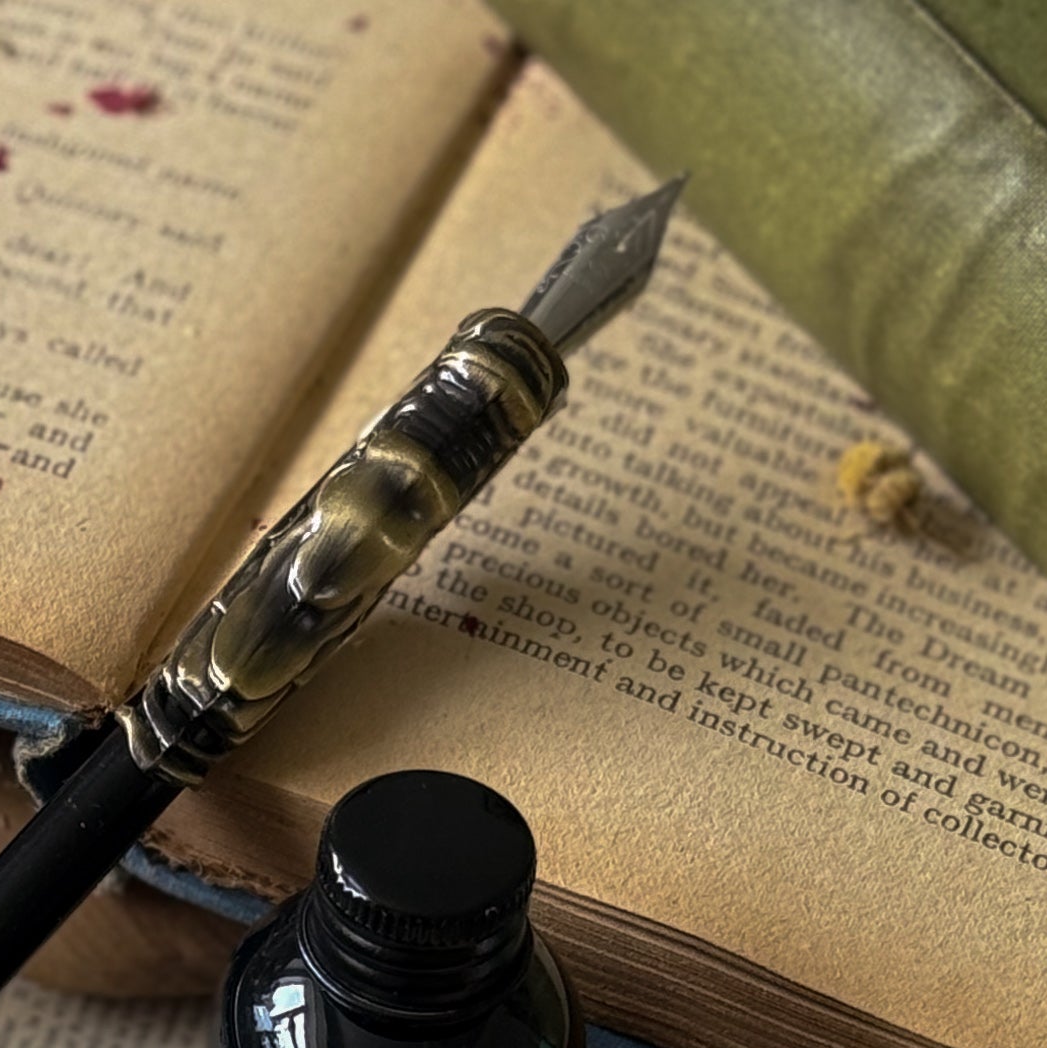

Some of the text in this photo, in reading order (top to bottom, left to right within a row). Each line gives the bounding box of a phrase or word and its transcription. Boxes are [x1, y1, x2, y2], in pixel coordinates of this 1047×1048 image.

[46, 337, 145, 377] called
[54, 399, 110, 427] she
[9, 449, 77, 480] and
[27, 422, 95, 454] and
[623, 452, 735, 516] talking
[743, 498, 840, 556] about
[846, 539, 896, 578] his
[513, 470, 1031, 699] details bored her. The Dream
[519, 506, 660, 573] pictured
[753, 598, 847, 652] faded
[873, 649, 952, 699] from
[681, 506, 868, 597] but became
[390, 576, 606, 682] ntertainment
[615, 676, 682, 713] and
[688, 700, 869, 794] instruction
[880, 783, 919, 814] of
[436, 568, 958, 799] the shop, to be kept swept and
[442, 541, 987, 778] precious objects which came and
[455, 508, 1047, 775] come sort of small pantechnicon,
